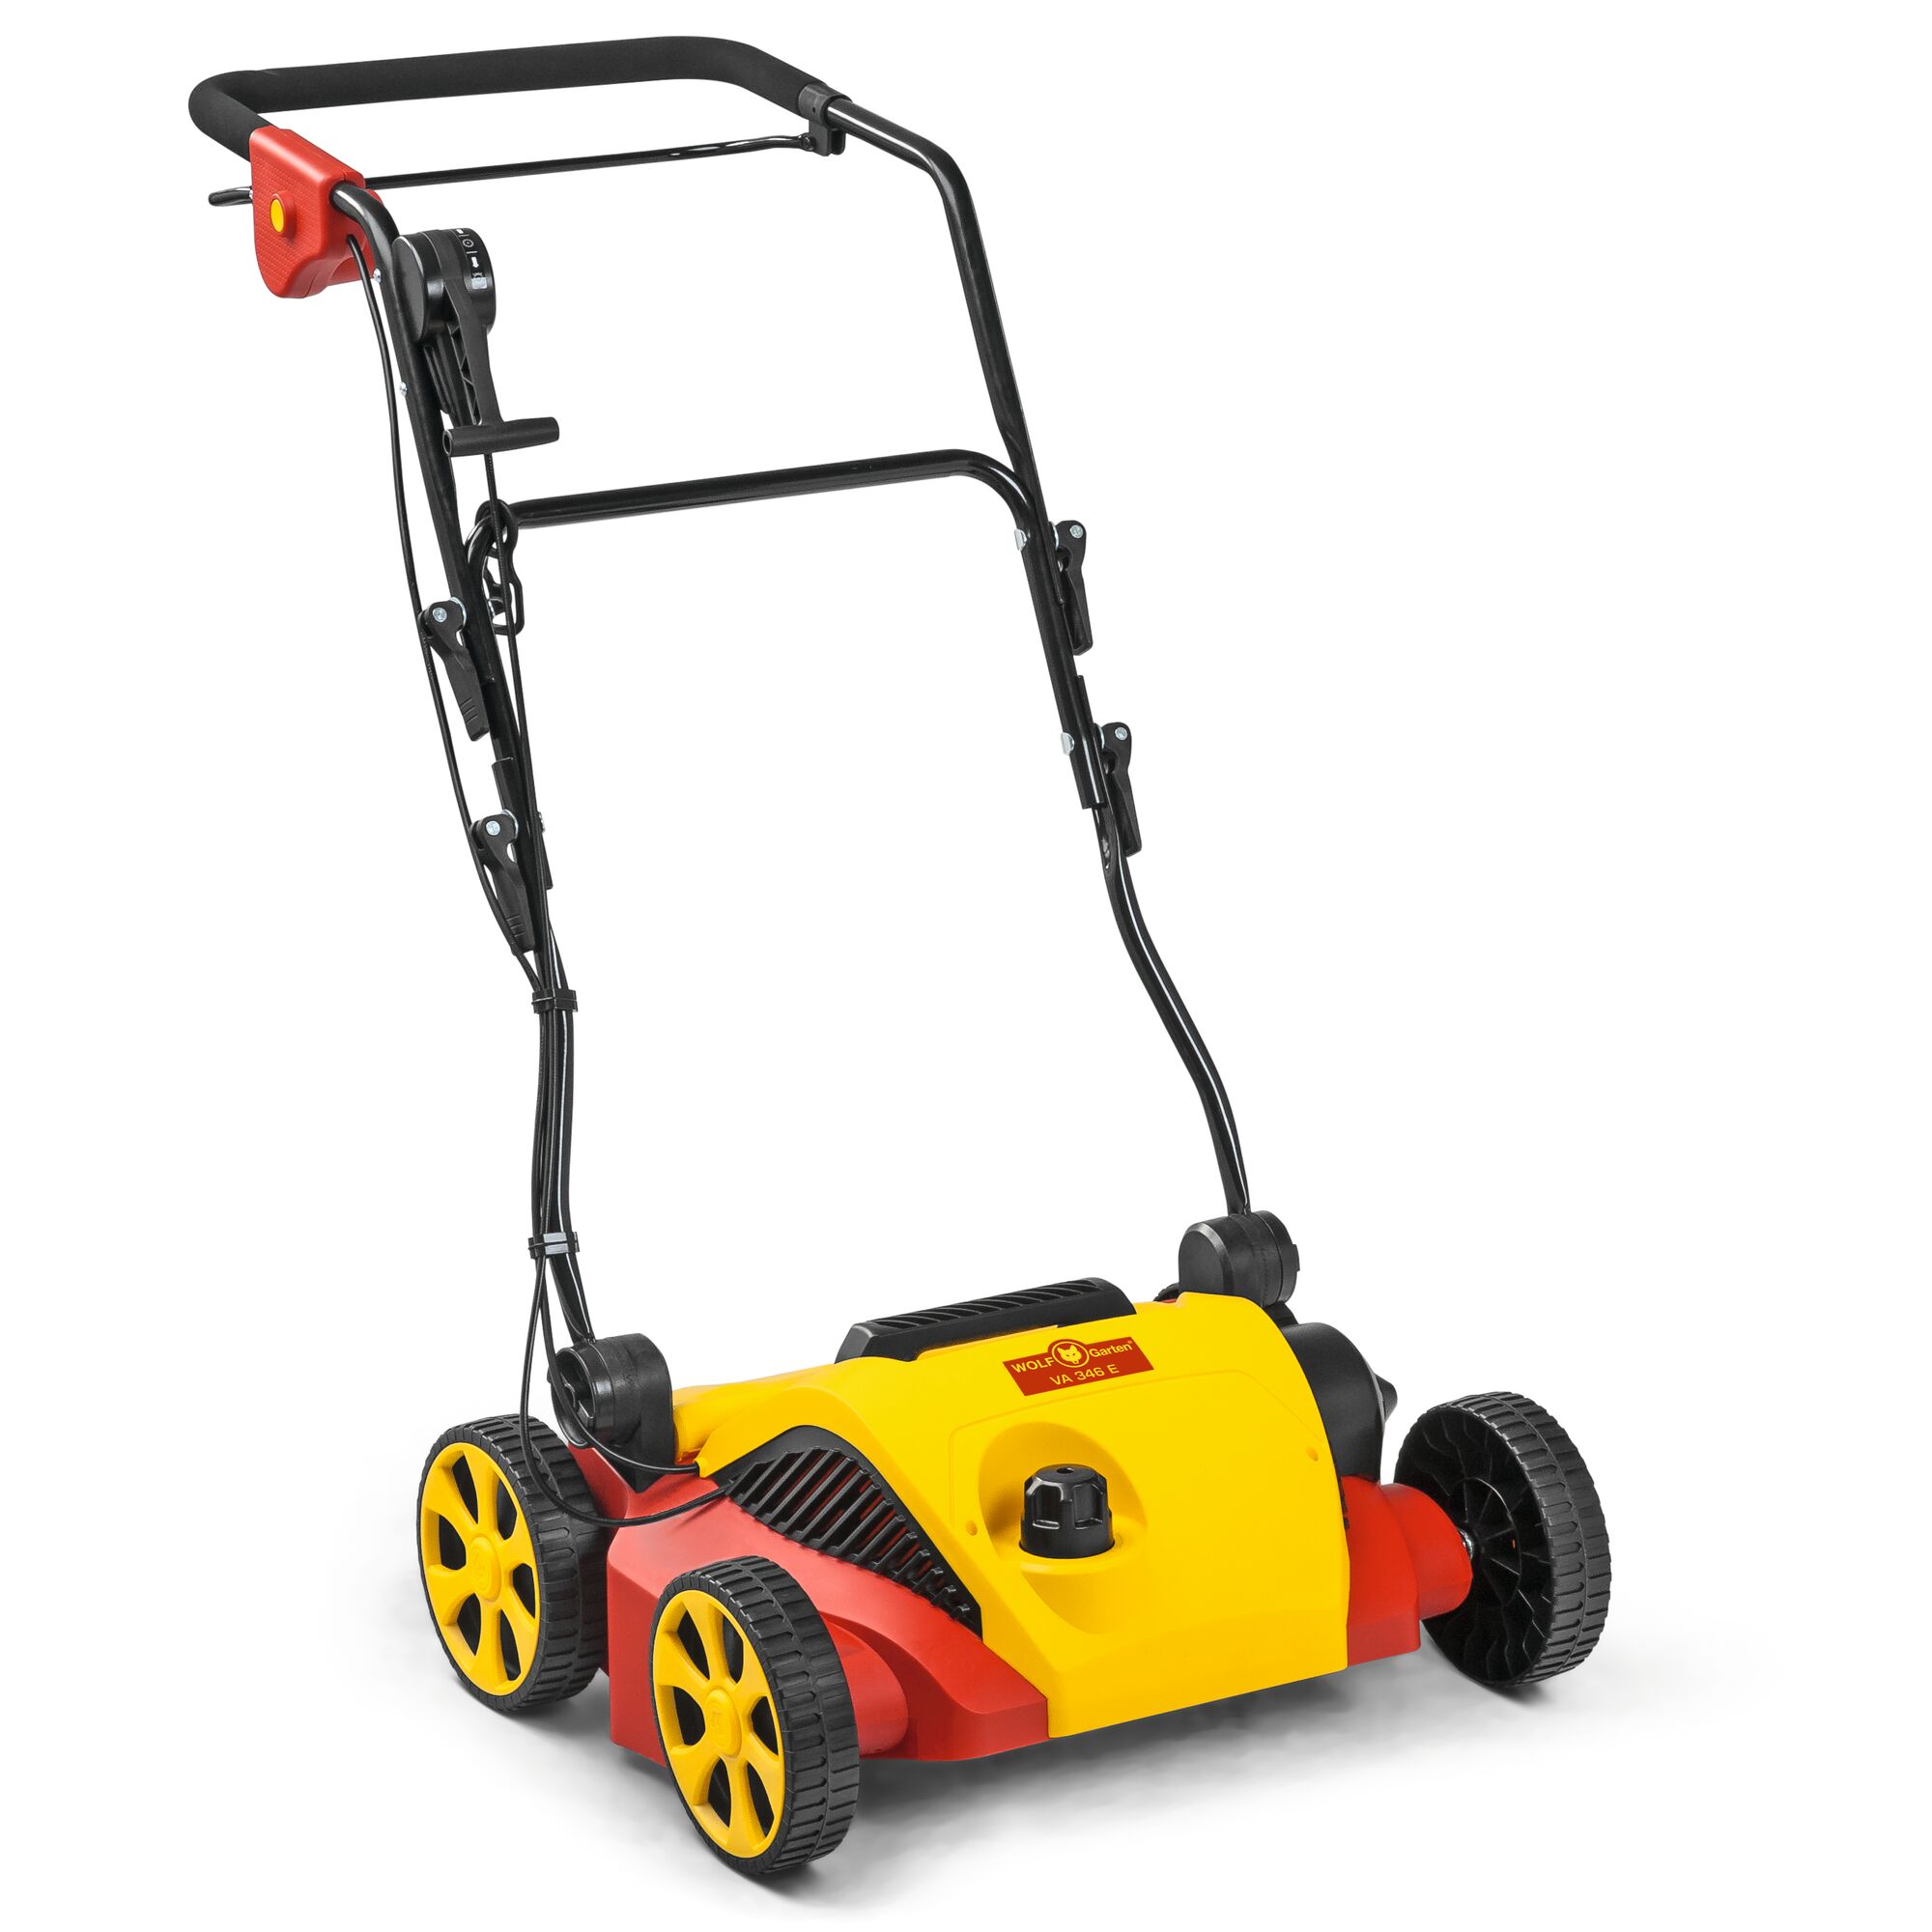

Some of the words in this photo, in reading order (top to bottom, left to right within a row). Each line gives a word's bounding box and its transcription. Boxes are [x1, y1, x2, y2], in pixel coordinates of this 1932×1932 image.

[1010, 1356, 1055, 1373] WOLF
[1049, 1374, 1073, 1386] VA
[1074, 1367, 1105, 1381] 346
[1107, 1364, 1120, 1375] E
